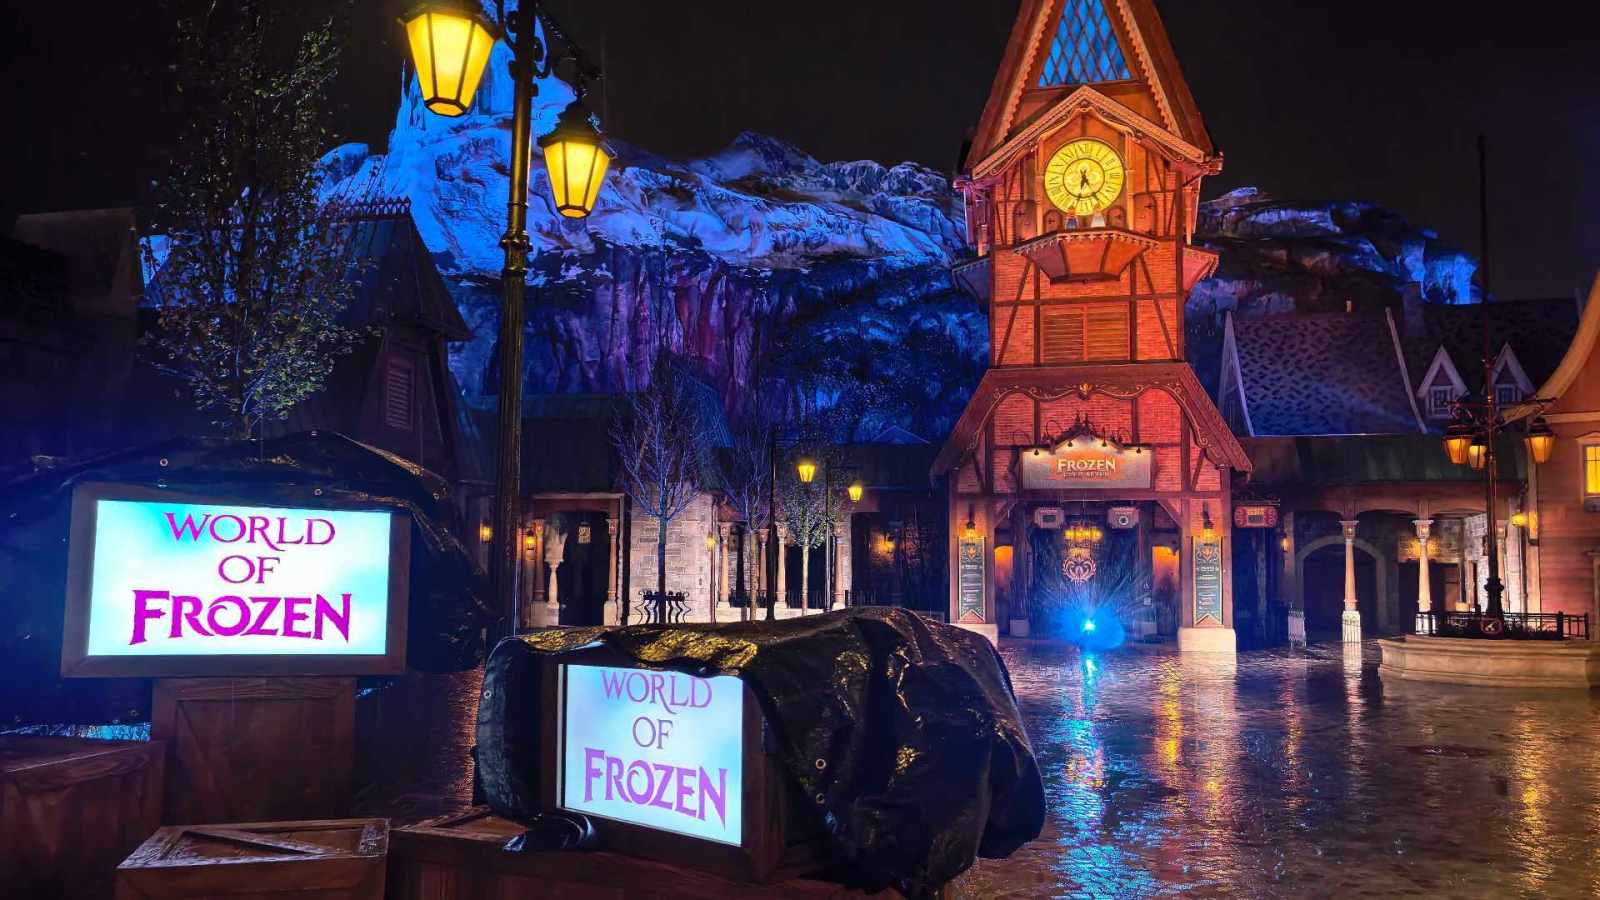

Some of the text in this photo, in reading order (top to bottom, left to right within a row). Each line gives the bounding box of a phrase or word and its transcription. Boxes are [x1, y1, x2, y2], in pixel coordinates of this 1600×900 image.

[1057, 457, 1116, 473] FROZEN
[164, 512, 336, 551] WORLD
[218, 555, 280, 584] OF
[129, 589, 352, 645] FROZEN
[601, 670, 713, 714] WORLD
[632, 716, 674, 750] OF
[584, 747, 728, 831] FROZEN
